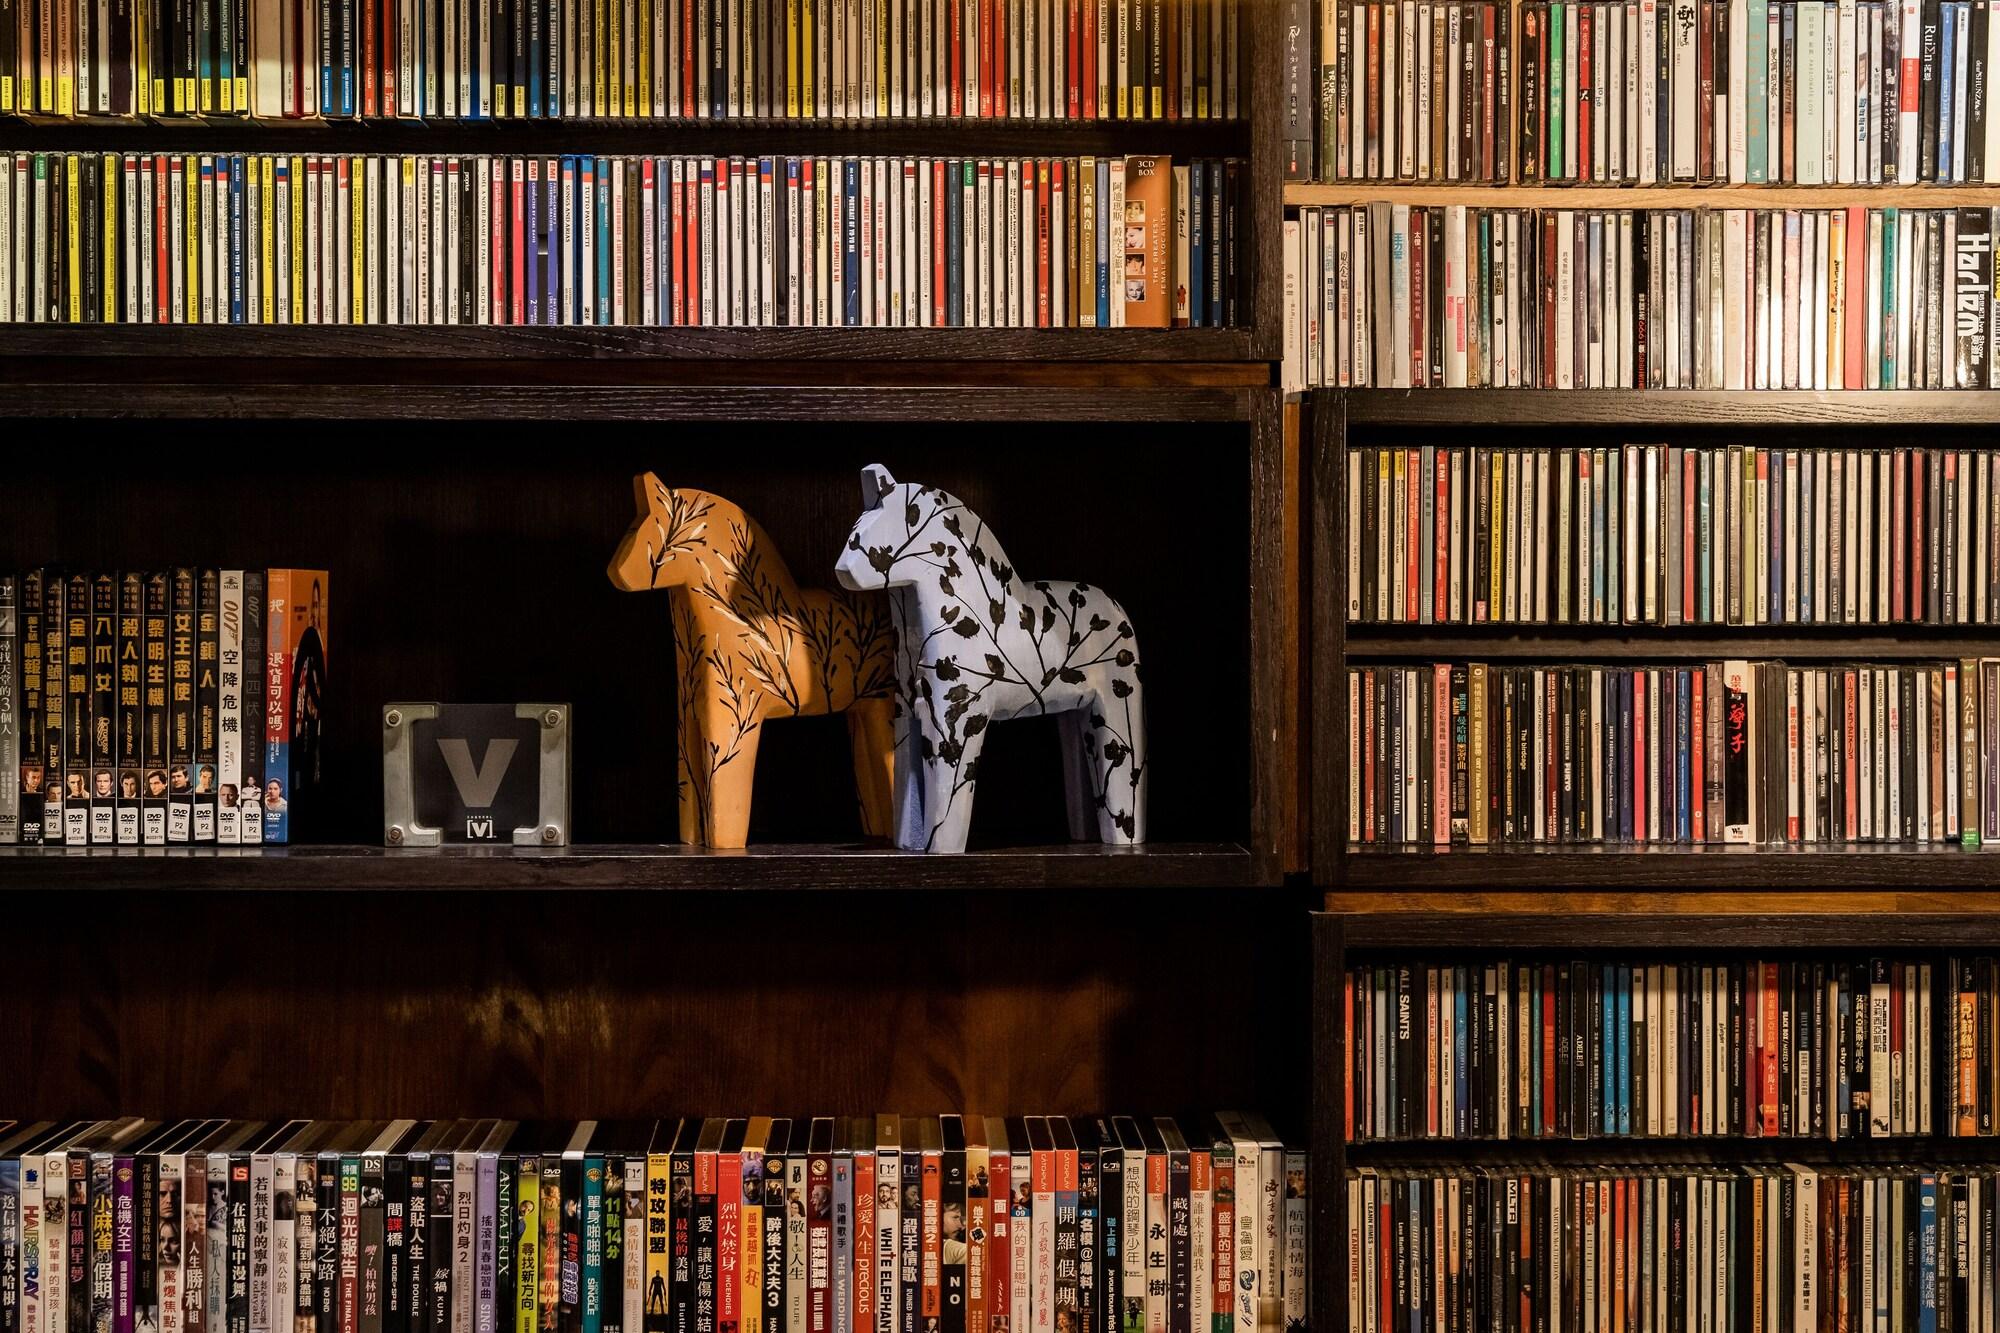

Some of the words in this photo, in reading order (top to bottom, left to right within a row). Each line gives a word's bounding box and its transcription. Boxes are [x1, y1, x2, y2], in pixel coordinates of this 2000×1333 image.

[1958, 233, 1989, 336] Harlem
[96, 617, 112, 691] 八爪女
[122, 619, 138, 706] 殺人執照
[148, 619, 164, 706] 黎明生機
[174, 614, 191, 702] 女王密使
[222, 650, 238, 732] 空降危機
[436, 739, 520, 807] V
[1400, 994, 1410, 1040] SAINTS
[1838, 1048, 1848, 1065] shy
[1838, 1066, 1848, 1085] guy
[342, 1177, 357, 1192] 99
[650, 1178, 666, 1253] 特攻聯盟
[1126, 1166, 1139, 1264] 想飛的鋼琴少年
[1586, 1186, 1594, 1205] MR
[1586, 1207, 1594, 1225] BIG
[117, 1195, 132, 1252] 危機女王
[231, 1202, 246, 1298] 在黑暗中漫舞
[387, 1203, 403, 1246] 間諜橋
[605, 1198, 621, 1259] 11點14分
[676, 1218, 688, 1282] 最後的美麗
[721, 1202, 737, 1271] 烈火焚身
[857, 1194, 872, 1255] 珍愛人生
[903, 1218, 917, 1282] 殺手情歌
[994, 1200, 1006, 1237] 面具
[23, 1205, 39, 1301] HAIRSPRAY
[186, 1241, 203, 1324] 人生勝利組
[412, 1264, 420, 1281] THE
[521, 1243, 534, 1310] 尋找新方向
[766, 1218, 781, 1307] 醉後大丈夫3
[1014, 1220, 1026, 1297] 我的夏日戀曲
[1058, 1206, 1076, 1305] 開羅假期
[1150, 1224, 1166, 1296] 永生樹
[1218, 1212, 1231, 1293] 盛夏的聖誕節
[1398, 1280, 1404, 1289] My
[164, 1270, 176, 1327] 驚爆焦點
[412, 1284, 420, 1317] DOUBLE
[481, 1304, 490, 1331] SING
[587, 1278, 595, 1315] SINGLE
[856, 1258, 873, 1314] precious
